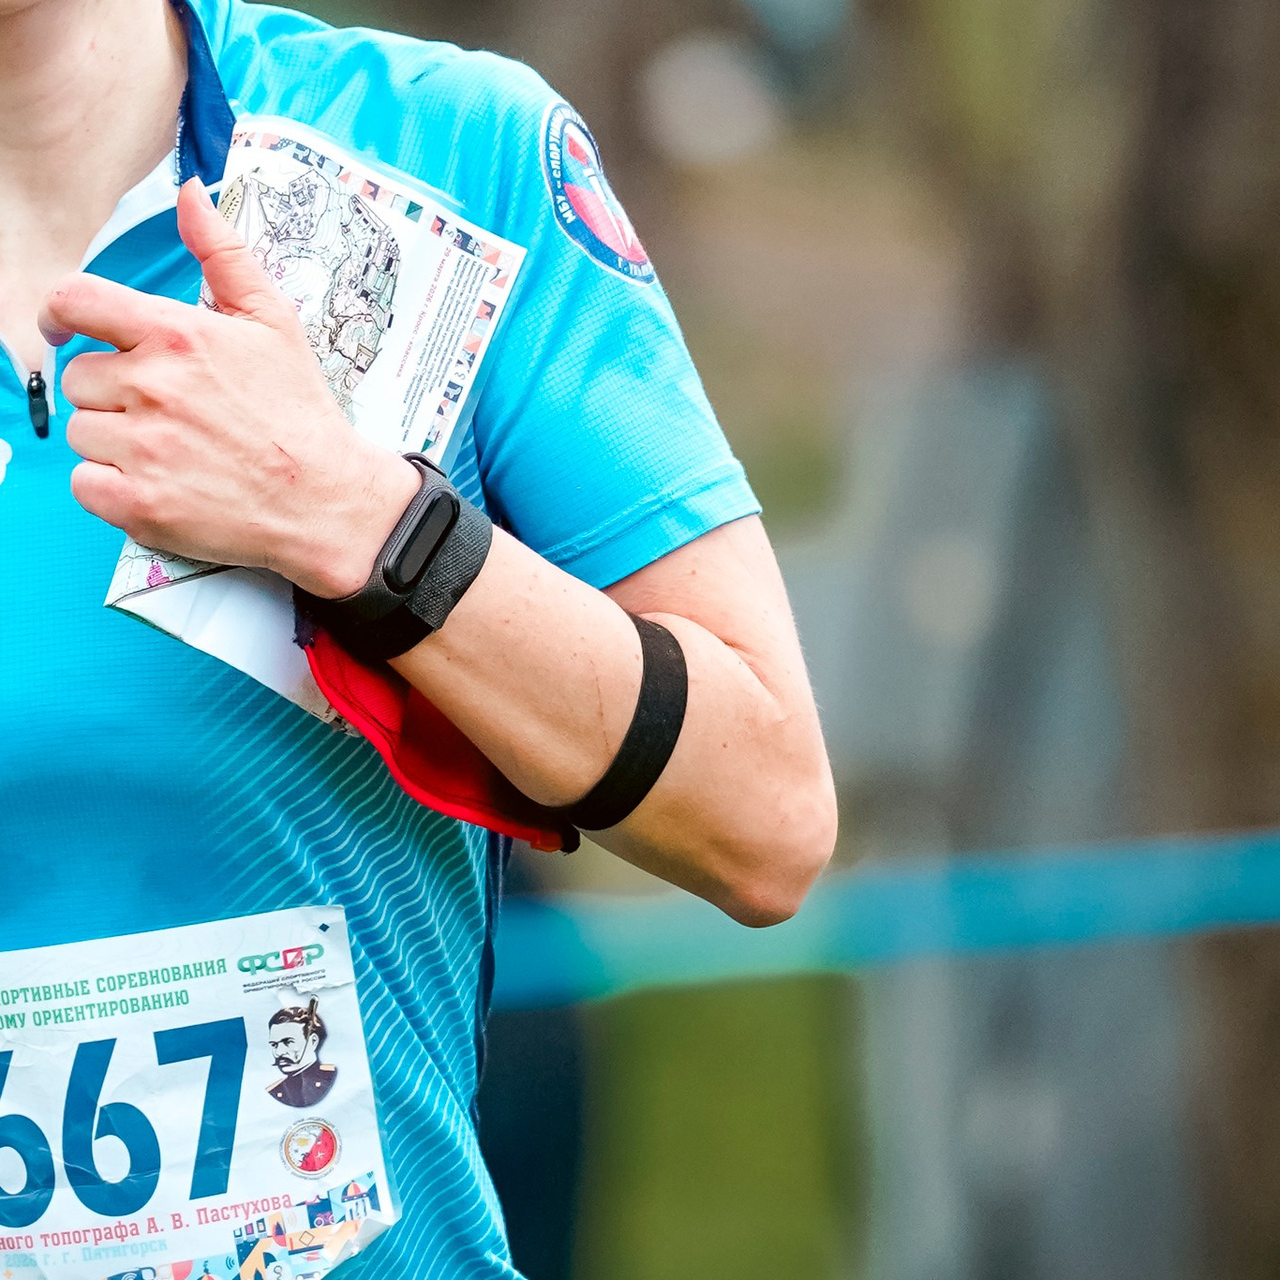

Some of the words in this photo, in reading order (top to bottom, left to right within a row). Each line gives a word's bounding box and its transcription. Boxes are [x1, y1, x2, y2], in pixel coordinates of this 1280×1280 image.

[555, 195, 576, 224] МБУ
[442, 246, 451, 257] 29
[275, 263, 286, 280] 20
[432, 257, 447, 282] марта
[424, 283, 437, 303] 2026
[411, 309, 426, 335] Кросс
[394, 340, 414, 378] классика
[96, 958, 228, 994] СОРЕВНОВАНИЯ
[32, 989, 190, 1027] ОРИЕНТИРОВАНИЮ
[40, 1220, 140, 1247] топографа
[147, 1216, 165, 1234] А.
[170, 1212, 190, 1230] В.
[196, 1193, 293, 1226] Пастухова
[81, 1238, 168, 1262] Пятигорск
